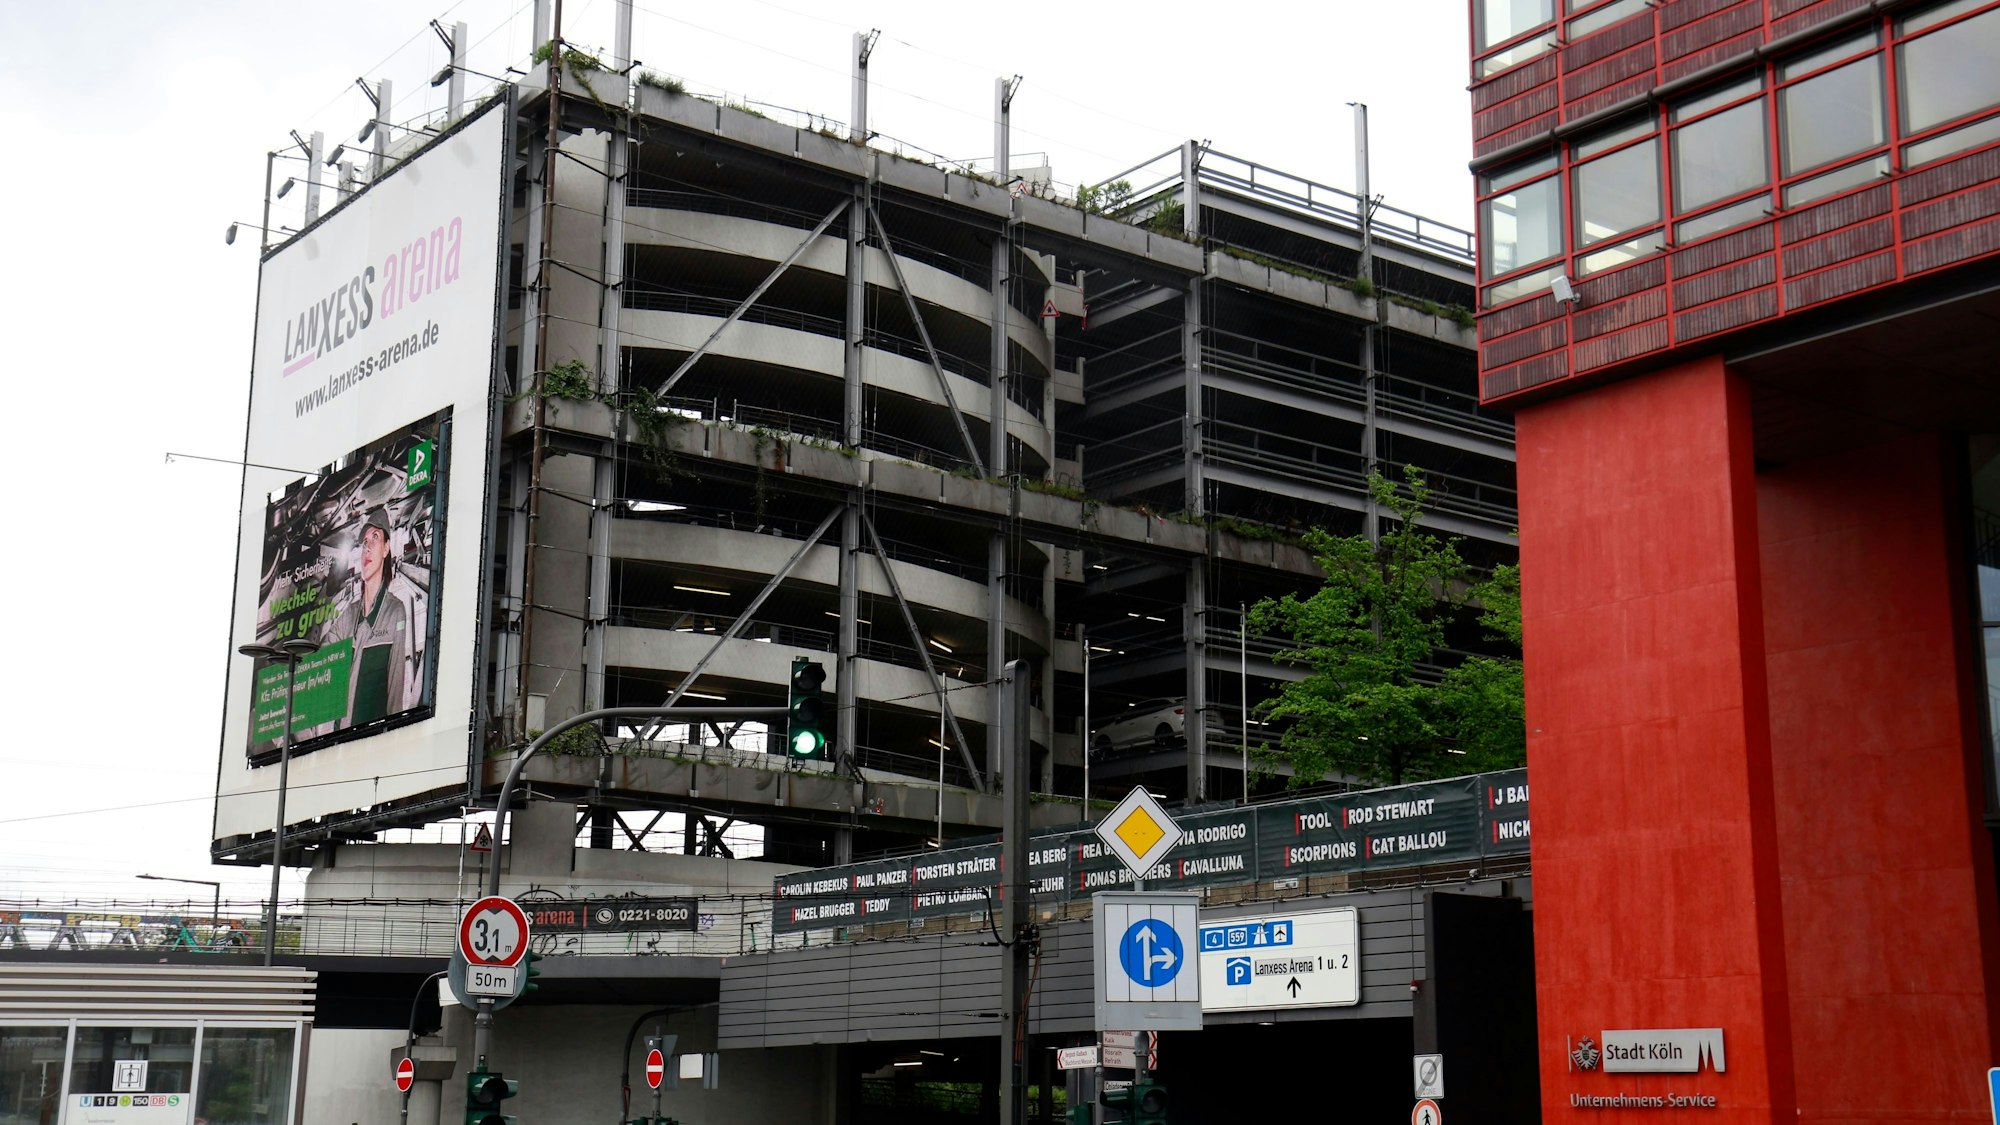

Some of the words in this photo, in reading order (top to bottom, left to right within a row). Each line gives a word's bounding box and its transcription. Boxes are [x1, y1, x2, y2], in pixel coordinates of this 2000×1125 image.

[283, 265, 375, 364] LANXESS
[380, 216, 462, 319] arena
[295, 319, 439, 419] www.lanxess-arena.de
[409, 469, 428, 486] DEKRA
[275, 618, 294, 640] zu
[1495, 788, 1503, 805] J
[1300, 811, 1332, 831] TOOL
[1348, 807, 1373, 825] ROD
[1376, 798, 1435, 822] STEWART
[1197, 823, 1246, 844] RODRIGO
[1372, 836, 1395, 855] CAT
[1398, 830, 1447, 852] BALLOU
[1042, 847, 1067, 864] BERG
[1083, 843, 1102, 859] REA
[1290, 841, 1357, 864] SCORPIONS
[916, 864, 955, 880] TORSTEN
[957, 856, 996, 876] STRÄTER
[1183, 854, 1244, 876] CAVALLUNA
[813, 877, 848, 894] KEBEKUS
[856, 873, 875, 888] PAUL
[877, 869, 907, 886] PANZER
[1085, 869, 1116, 888] JONAS
[619, 907, 689, 922] 0221-8020
[794, 906, 818, 921] HAZEL
[819, 902, 855, 919] BRUGGER
[865, 898, 890, 914] TEDDY
[536, 909, 575, 925] arena
[474, 918, 500, 953] 3,1
[1212, 934, 1218, 945] 4
[1230, 932, 1245, 943] 559
[1234, 966, 1245, 983] P
[1255, 959, 1287, 976] Lanxess
[1289, 957, 1313, 974] Arena
[1318, 956, 1323, 970] 1
[1327, 959, 1337, 970] u.
[1341, 954, 1348, 969] 2
[1606, 1042, 1645, 1060] Stadt
[1649, 1041, 1683, 1060] Köln
[108, 1098, 115, 1106] 9
[152, 1097, 165, 1105] DB
[168, 1096, 179, 1106] S
[1569, 1092, 1716, 1108] Unternehmens-Service
